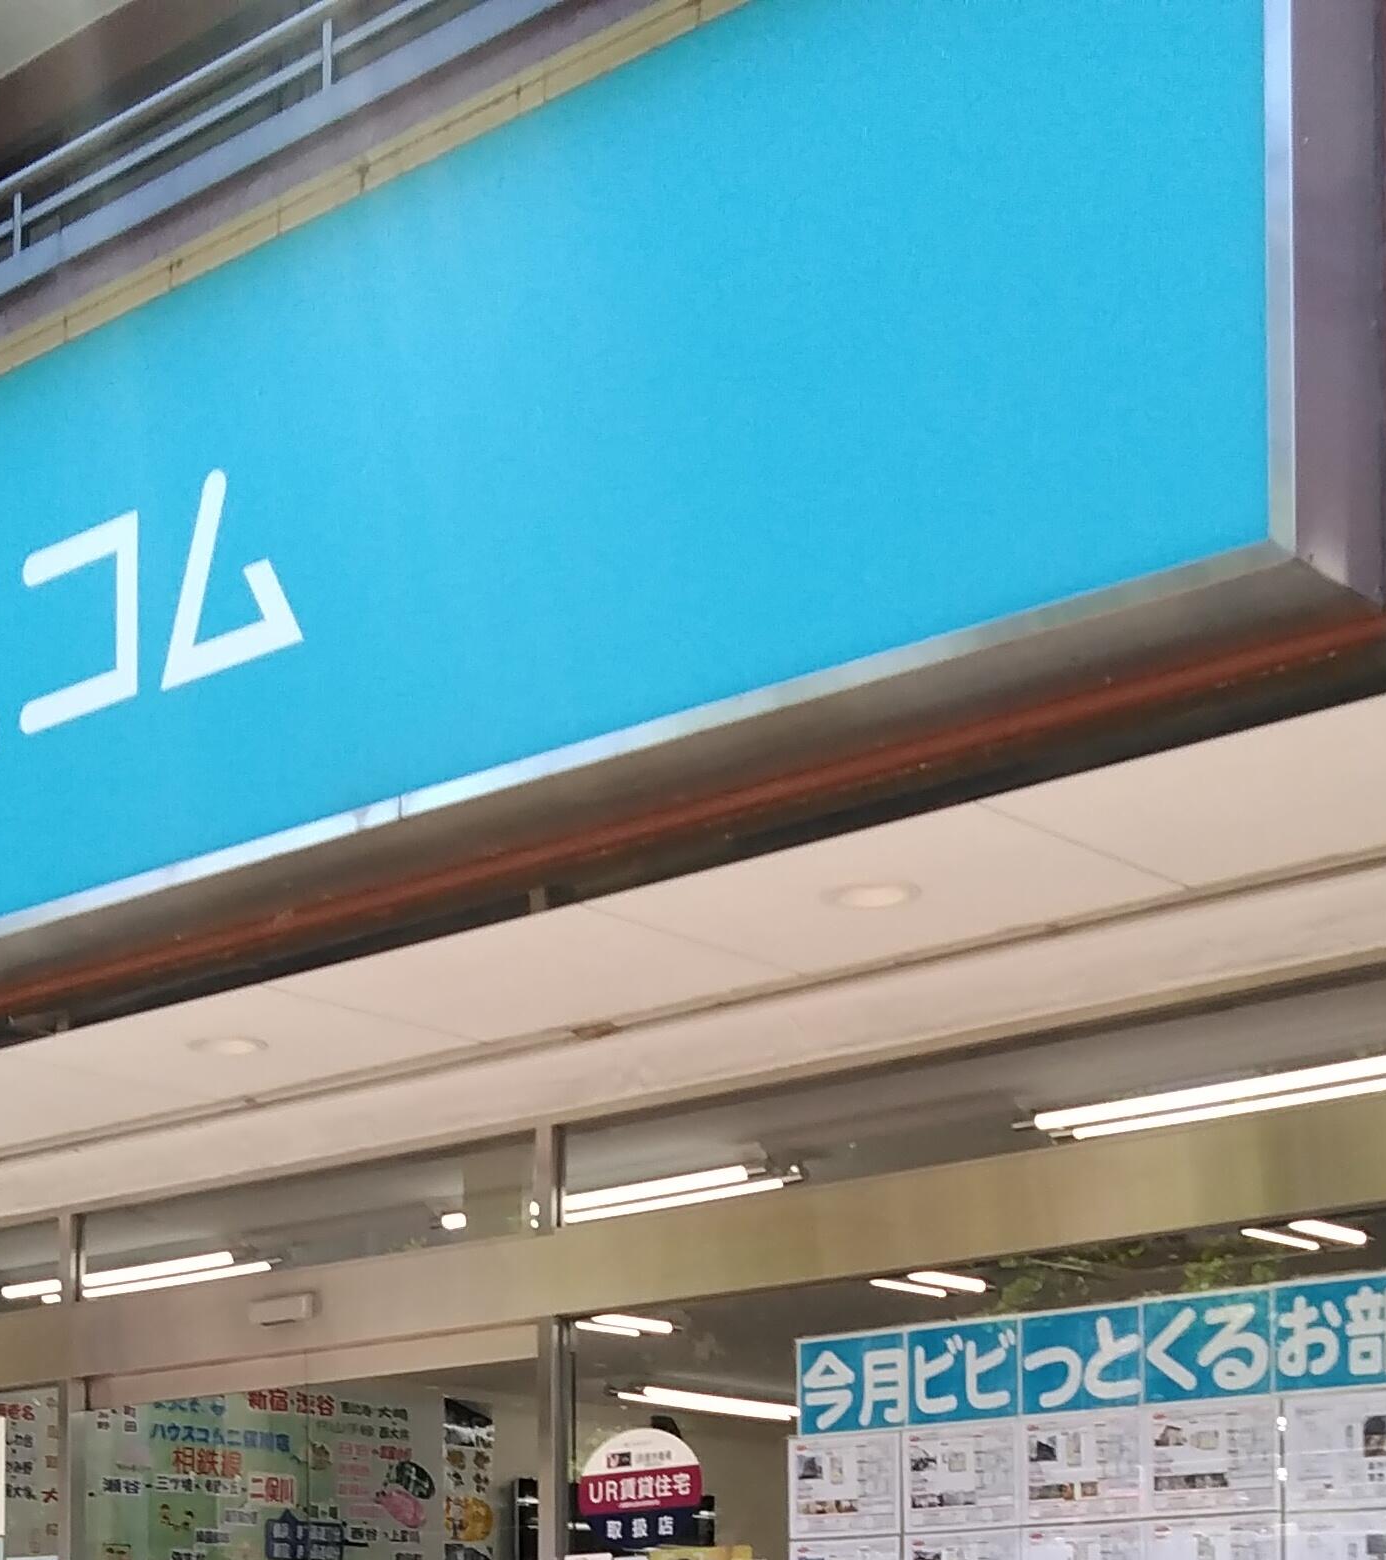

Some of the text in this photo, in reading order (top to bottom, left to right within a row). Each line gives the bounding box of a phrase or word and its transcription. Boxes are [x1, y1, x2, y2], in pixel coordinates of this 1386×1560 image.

[172, 1446, 243, 1477] 相鉄線
[103, 1476, 141, 1494] 瀬谷
[250, 1476, 295, 1504] 二俣川
[588, 1472, 692, 1504] UR賃貸住宅
[605, 1515, 675, 1541] 取扱店
